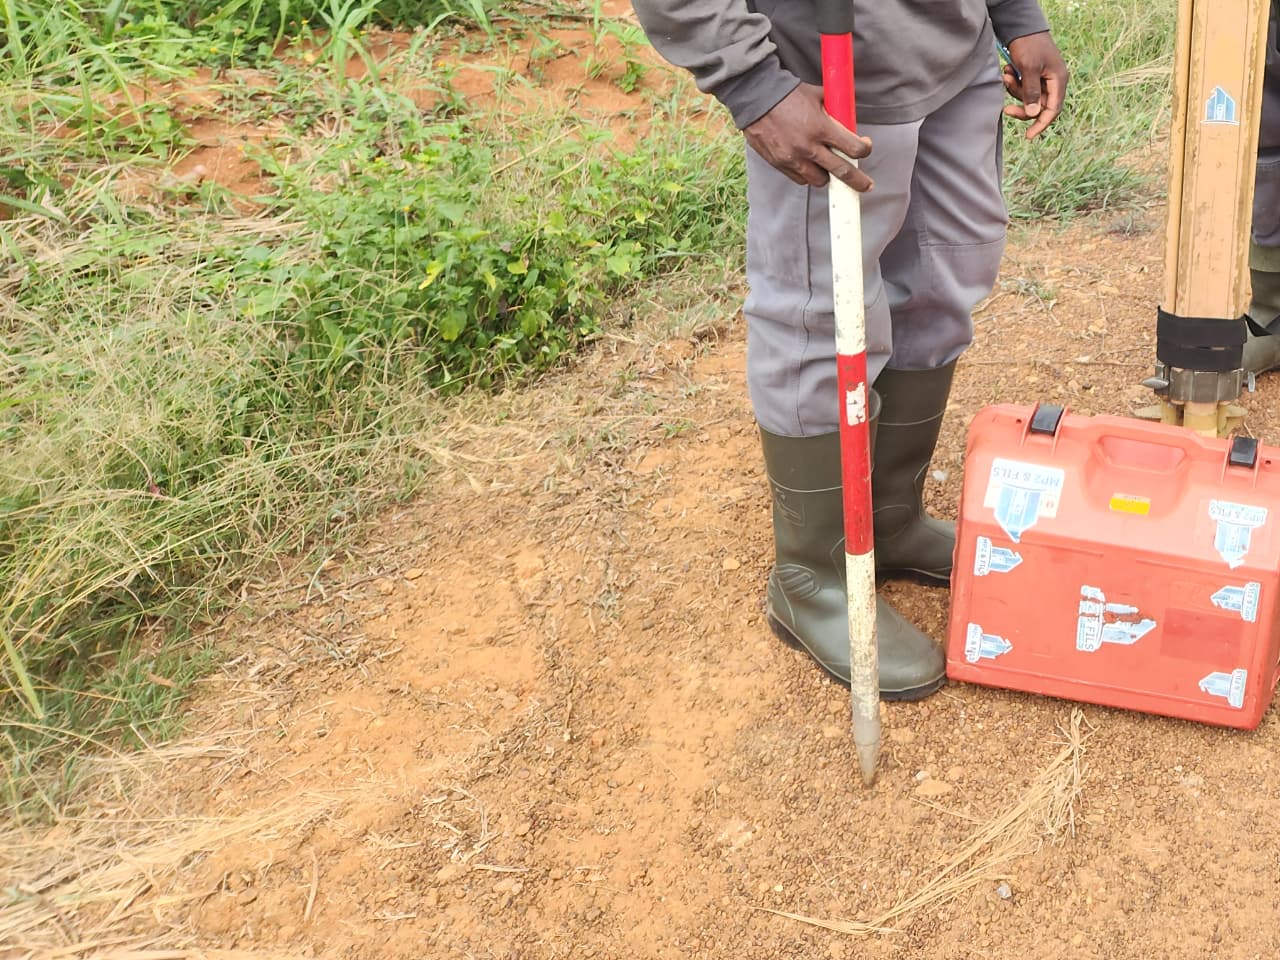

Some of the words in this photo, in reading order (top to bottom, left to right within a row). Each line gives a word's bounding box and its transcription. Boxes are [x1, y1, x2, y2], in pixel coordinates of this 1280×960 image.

[993, 467, 1020, 480] FILS
[1023, 472, 1031, 481] &
[1033, 474, 1060, 487] MP2
[1085, 626, 1095, 649] FILS
